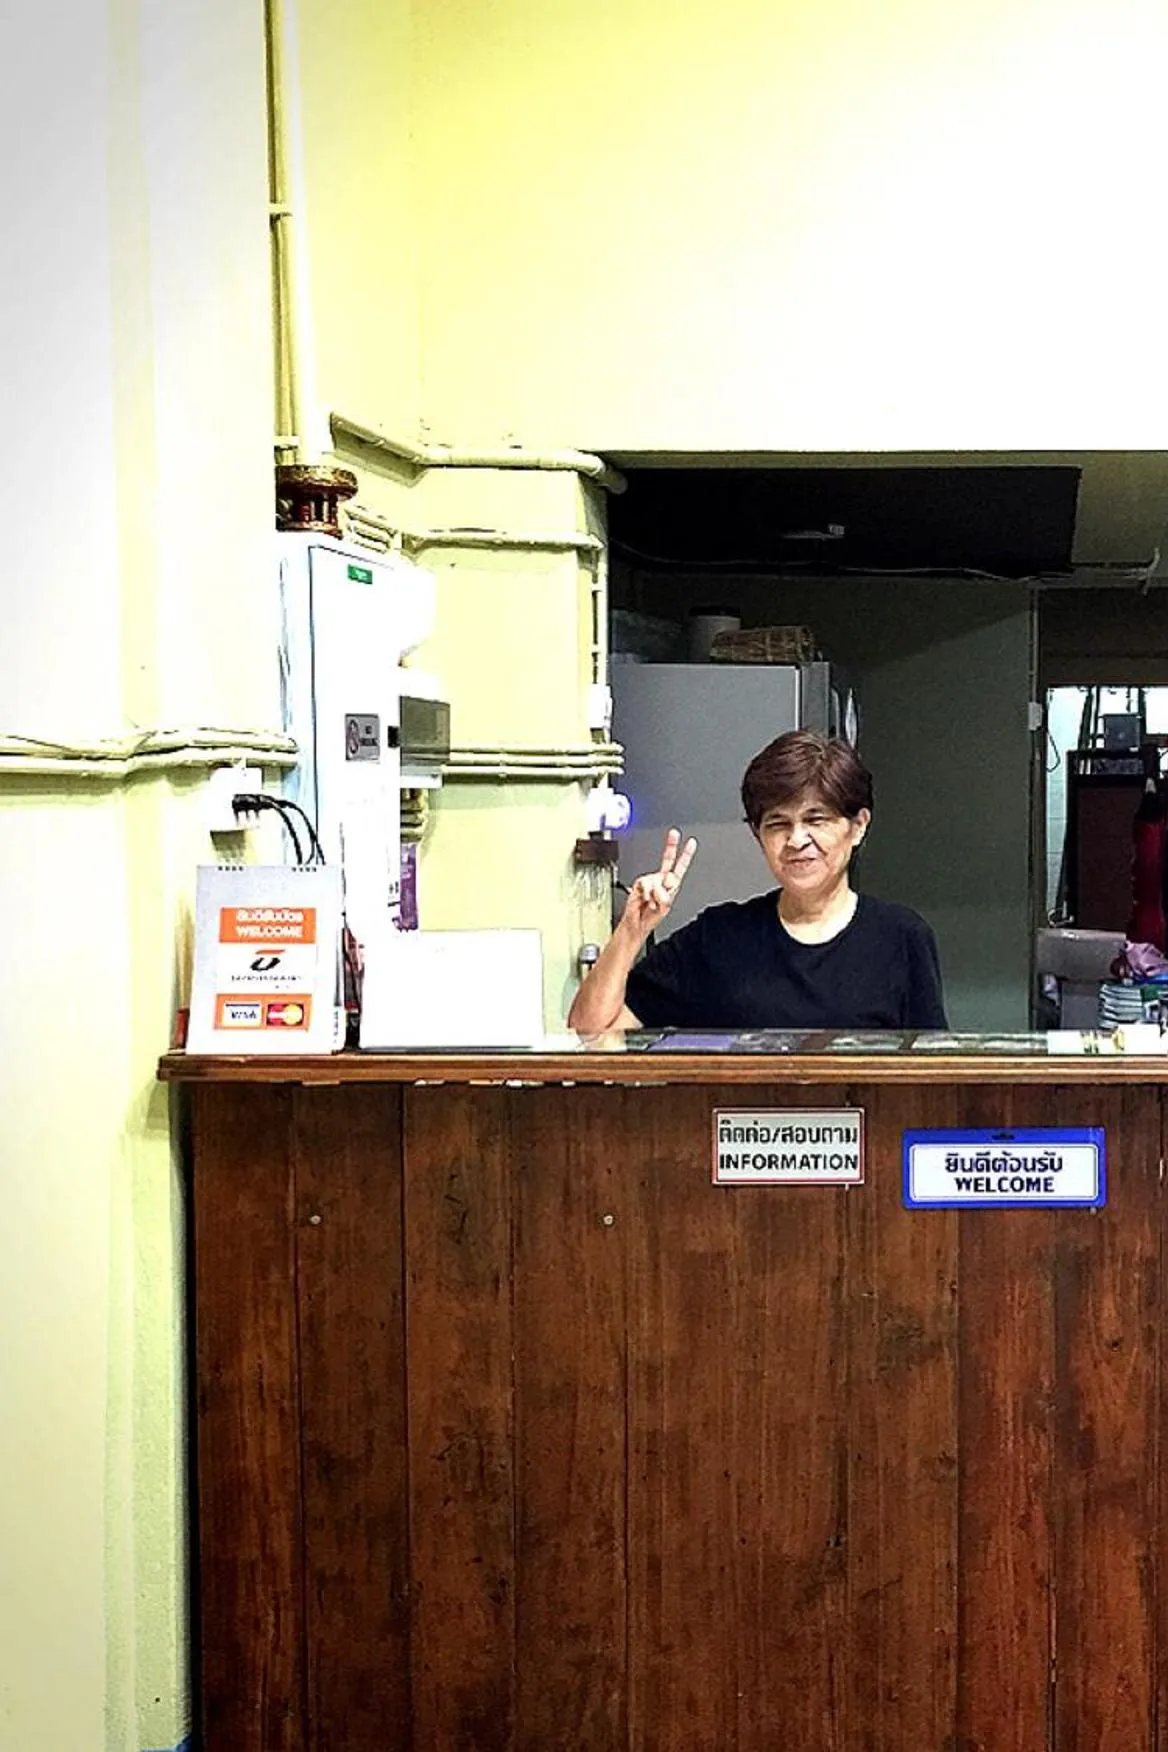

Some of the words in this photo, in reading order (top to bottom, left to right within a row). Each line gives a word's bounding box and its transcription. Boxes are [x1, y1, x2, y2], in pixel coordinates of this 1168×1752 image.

[236, 925, 304, 938] WELCOME
[719, 1153, 858, 1171] INFORMATION
[945, 1150, 1063, 1173] ยินดีต้อนรับ
[954, 1176, 1055, 1193] WELCOME
